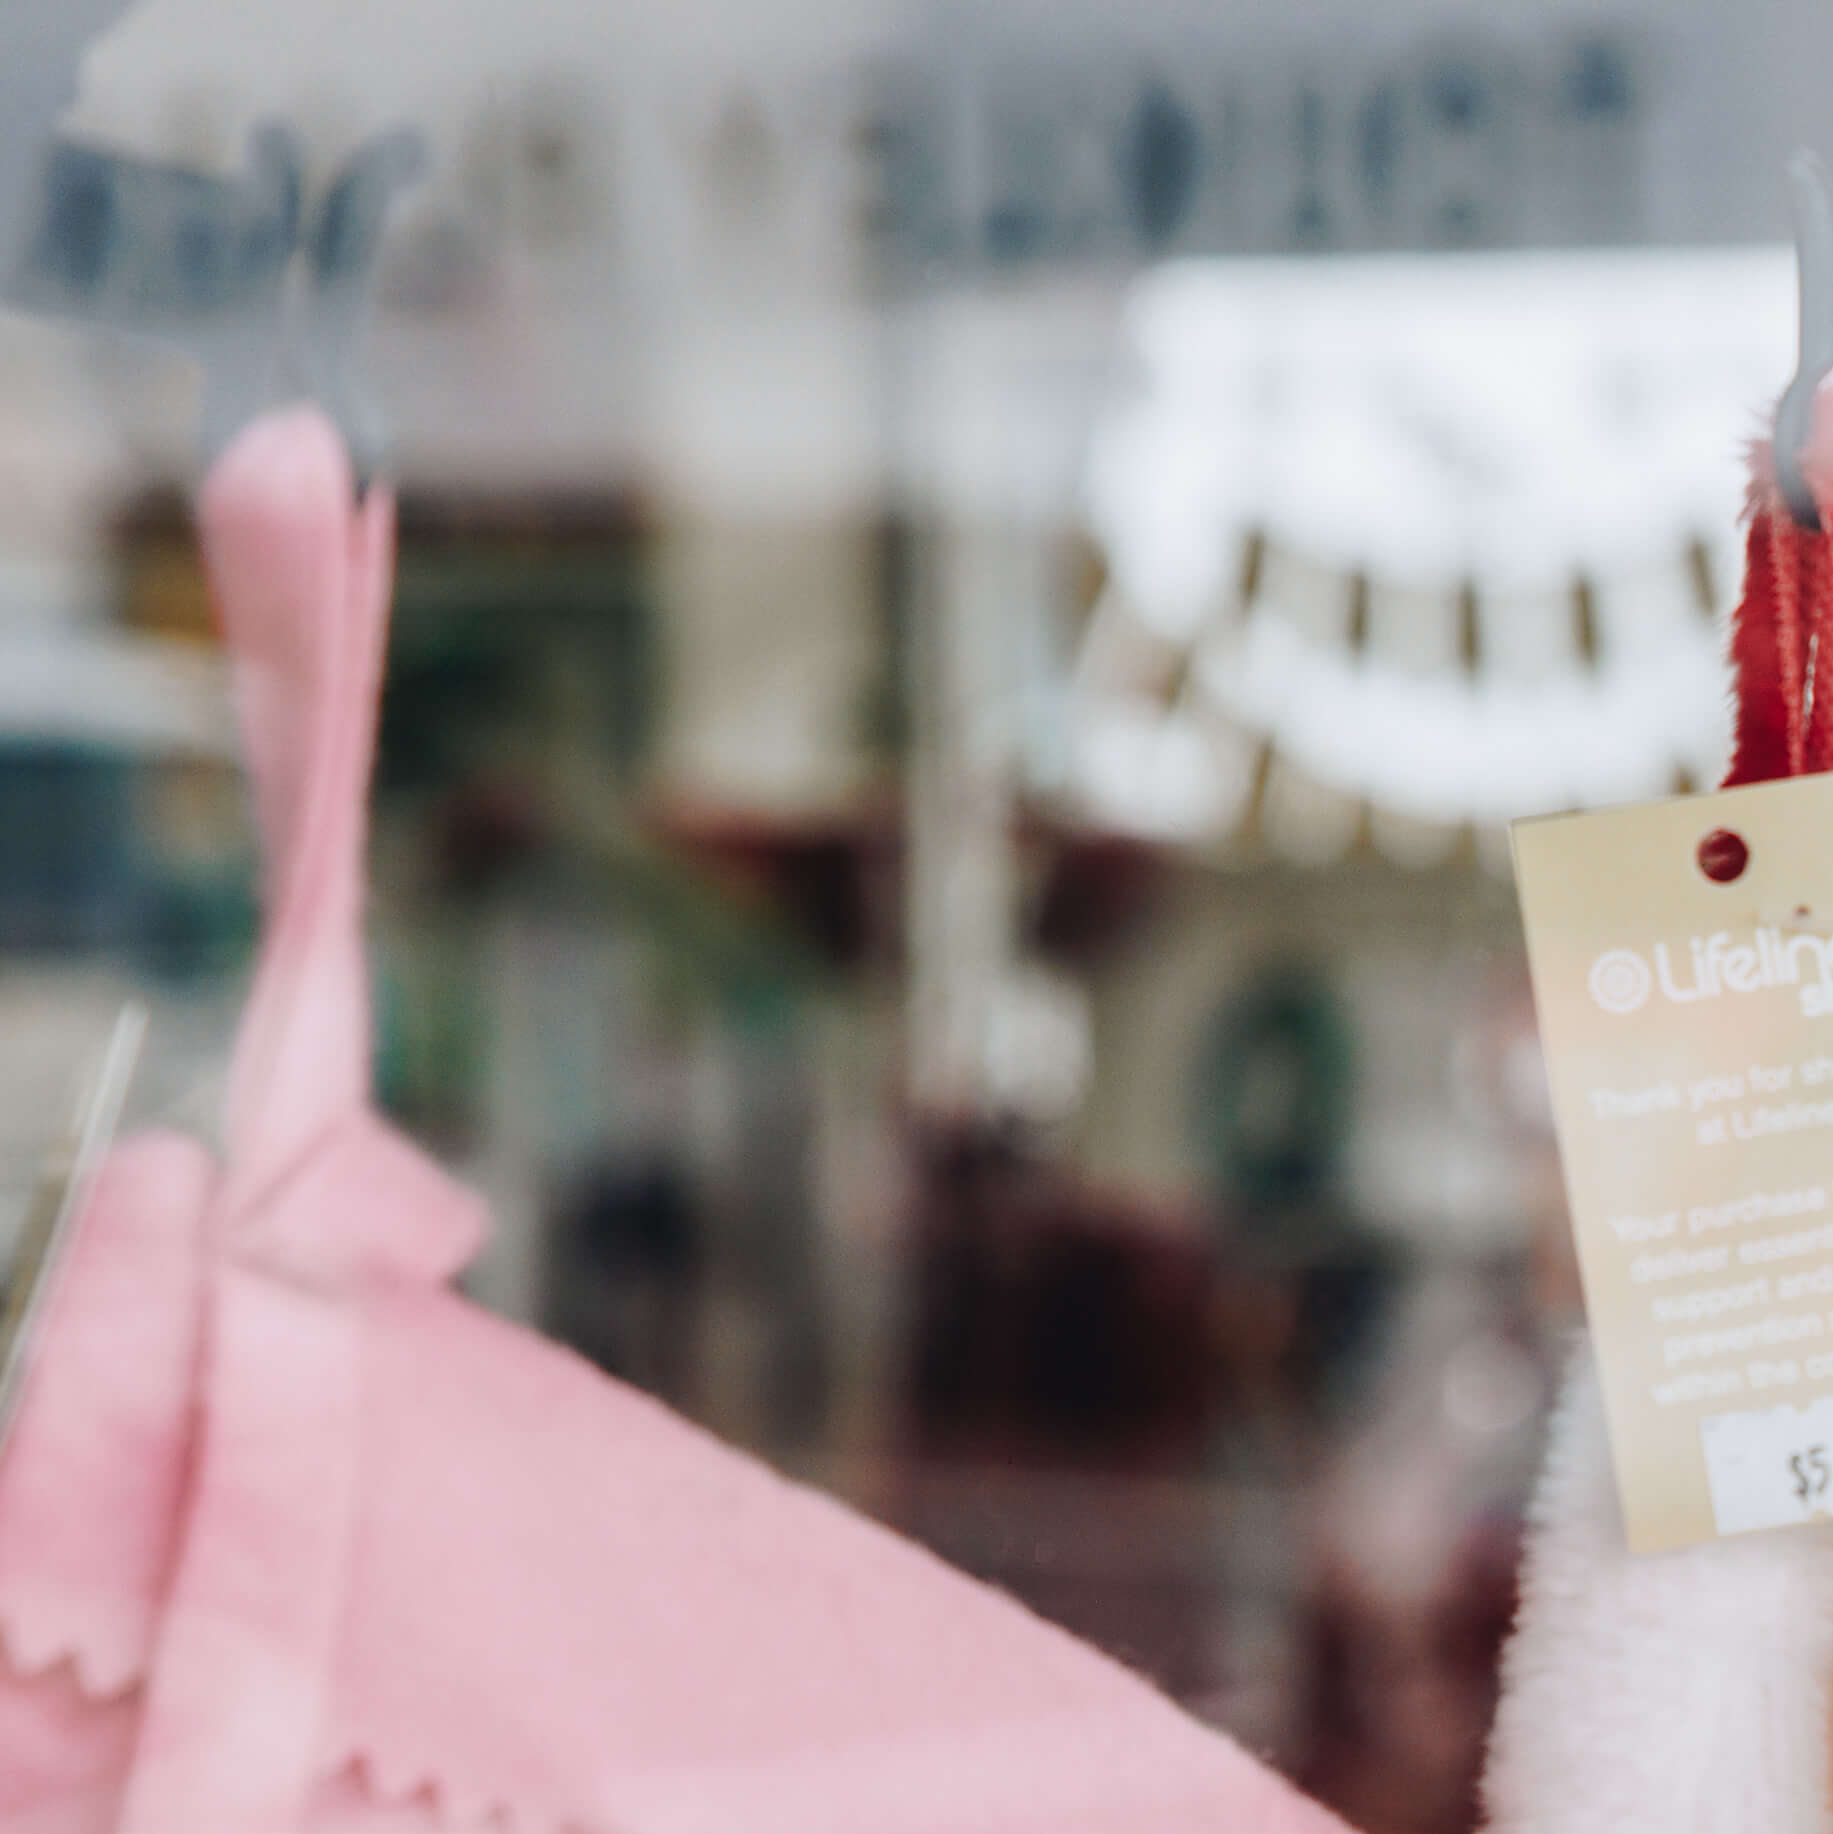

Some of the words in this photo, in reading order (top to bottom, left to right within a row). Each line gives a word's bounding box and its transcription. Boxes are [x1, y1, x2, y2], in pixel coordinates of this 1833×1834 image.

[1589, 1082, 1680, 1116] Thank
[1690, 1075, 1744, 1111] you
[1749, 1065, 1793, 1092] for
[1697, 1117, 1729, 1146] at
[1607, 1211, 1679, 1242] Your
[1688, 1185, 1829, 1238] purchase
[1630, 1246, 1730, 1286] deliver
[1650, 1276, 1771, 1324] support
[1663, 1312, 1825, 1369] prevention
[1650, 1369, 1743, 1408] within
[1746, 1359, 1800, 1390] the
[1788, 1442, 1832, 1508] $5
